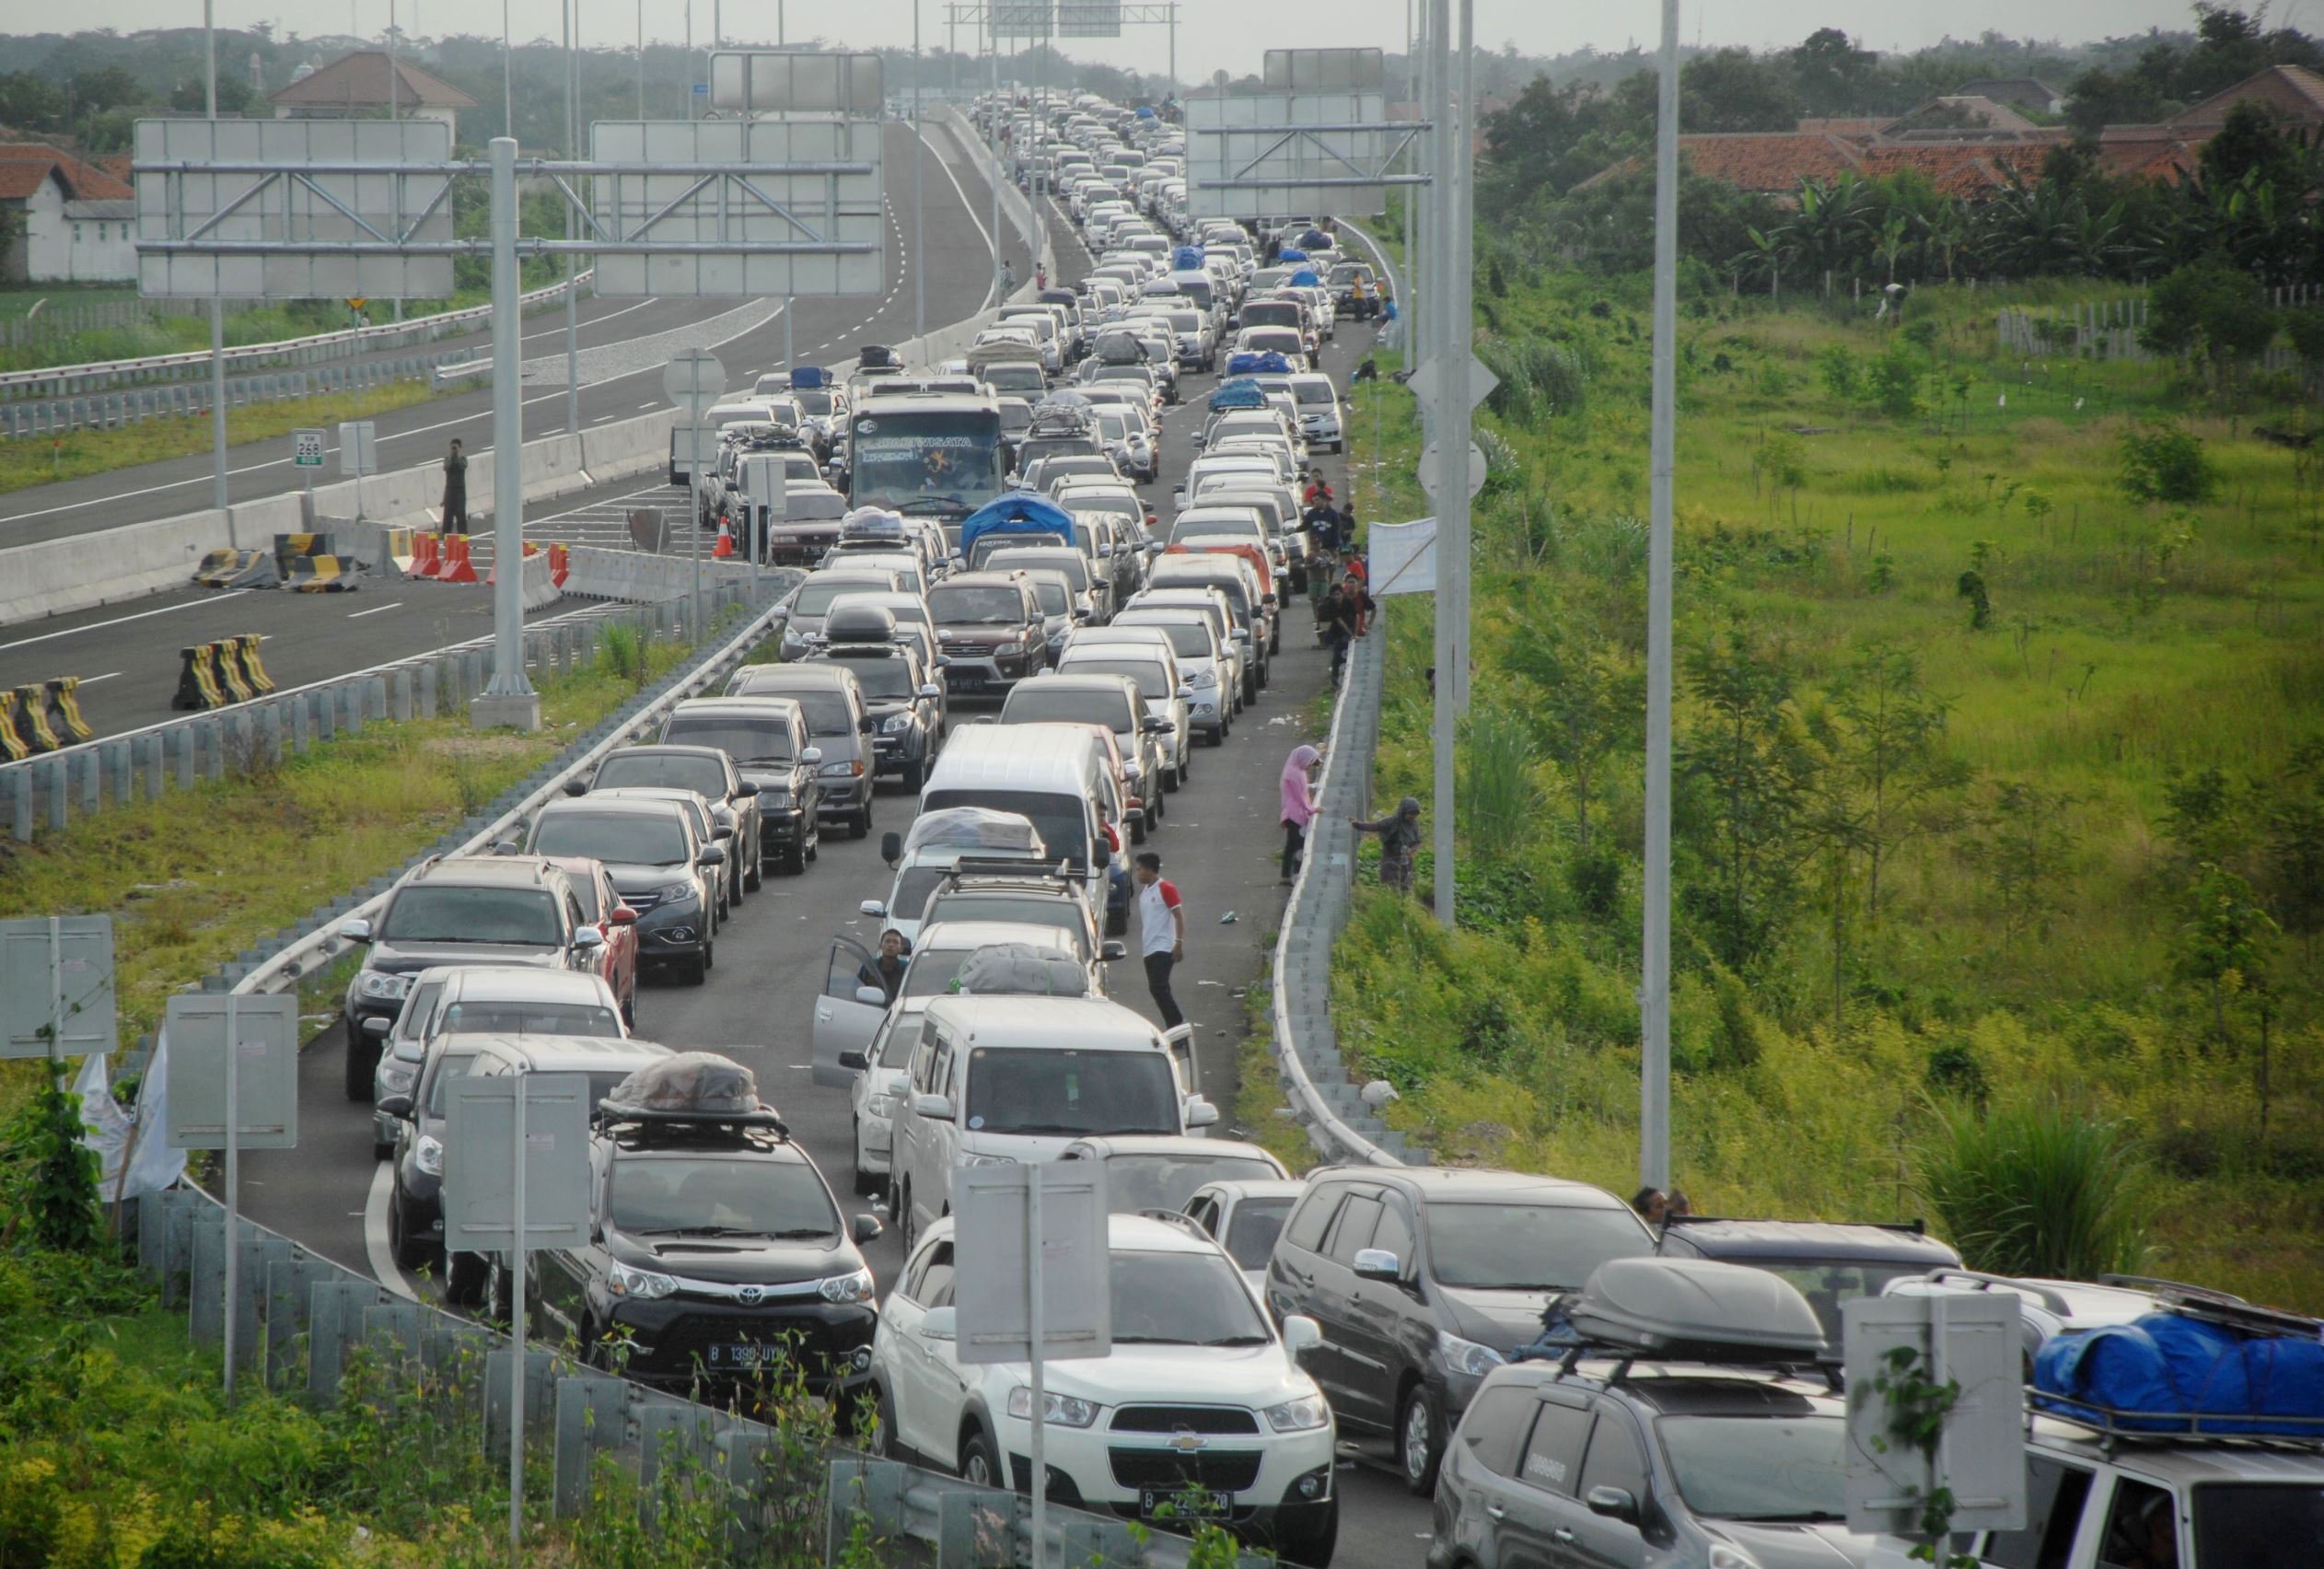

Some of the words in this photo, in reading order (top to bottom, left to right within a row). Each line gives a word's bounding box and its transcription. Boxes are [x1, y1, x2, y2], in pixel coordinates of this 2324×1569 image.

[298, 443, 320, 455] 268
[711, 1346, 719, 1361] B
[1145, 1493, 1154, 1508] B
